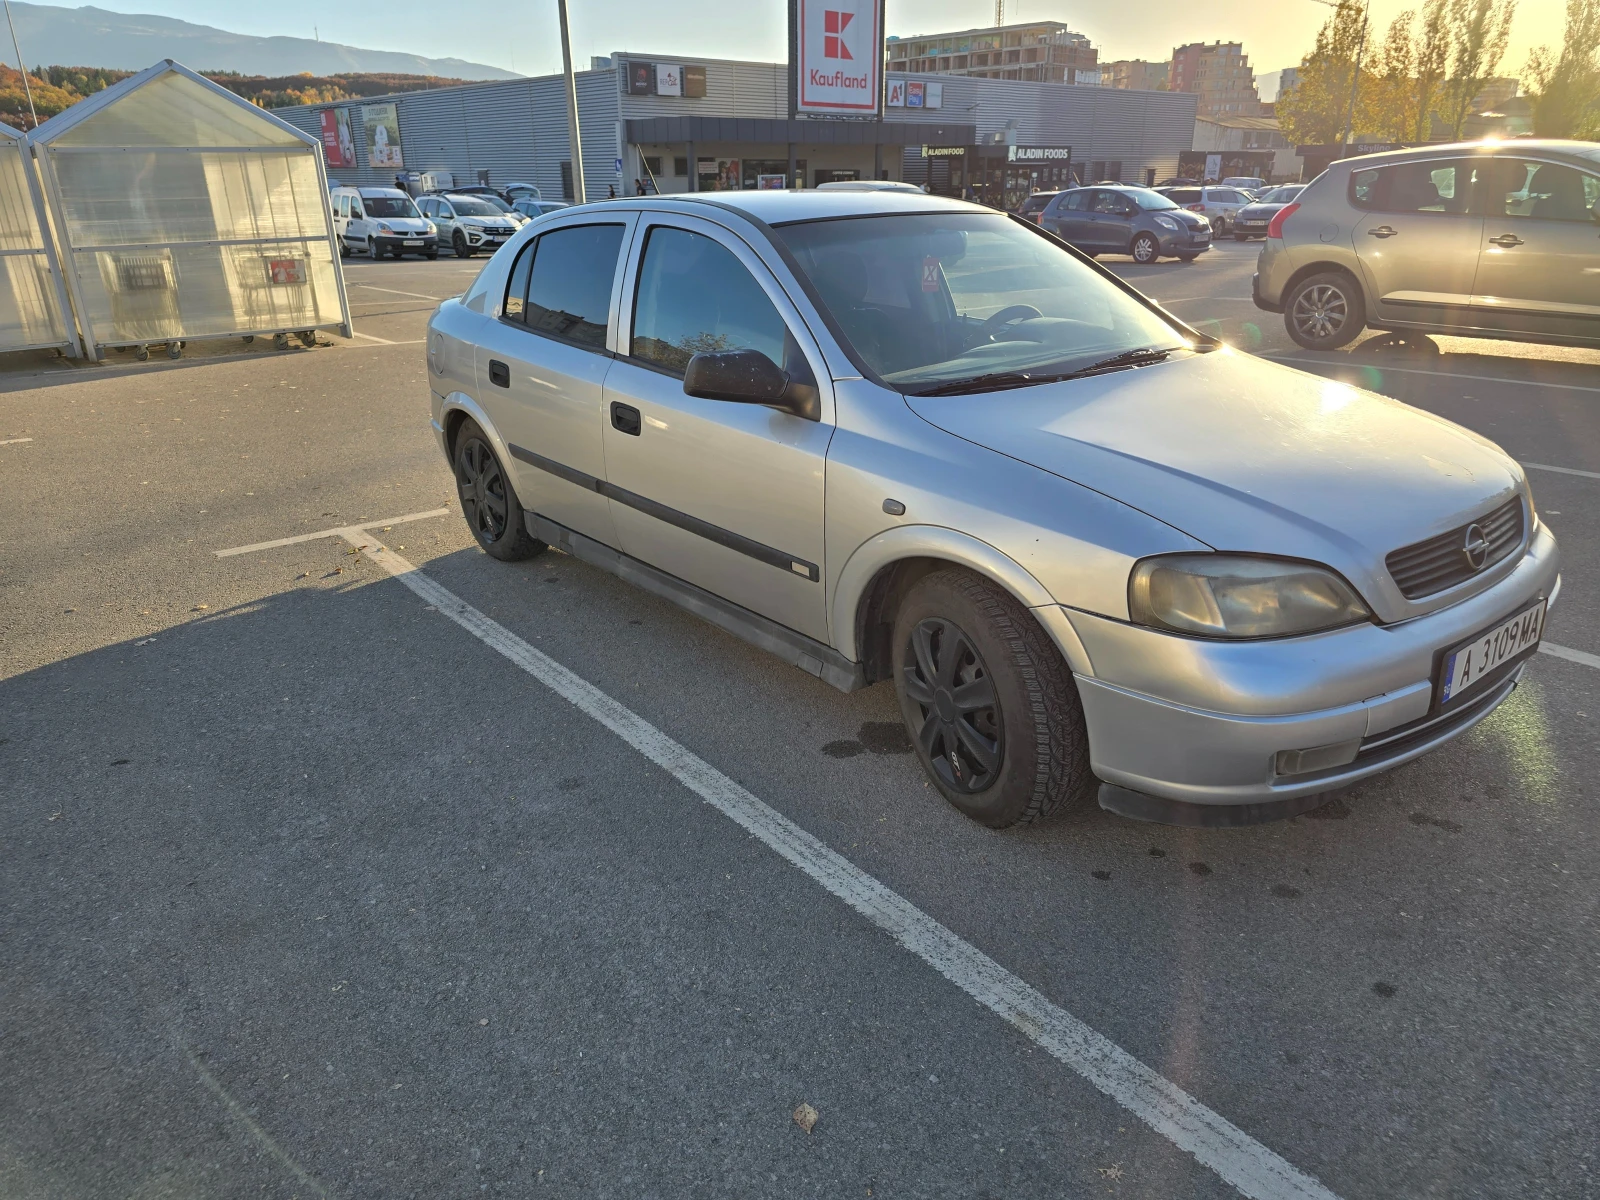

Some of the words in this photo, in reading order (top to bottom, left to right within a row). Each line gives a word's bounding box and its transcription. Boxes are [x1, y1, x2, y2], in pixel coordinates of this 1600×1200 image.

[810, 69, 867, 89] Kaufland
[890, 83, 903, 103] A1
[908, 86, 922, 96] Easy
[908, 95, 920, 104] Pay
[928, 148, 948, 156] ALADIN
[948, 147, 964, 155] FOOD
[1017, 148, 1043, 159] ALADIN
[1044, 148, 1068, 159] FOODS
[1358, 144, 1391, 153] Skyline
[1459, 649, 1472, 687] A
